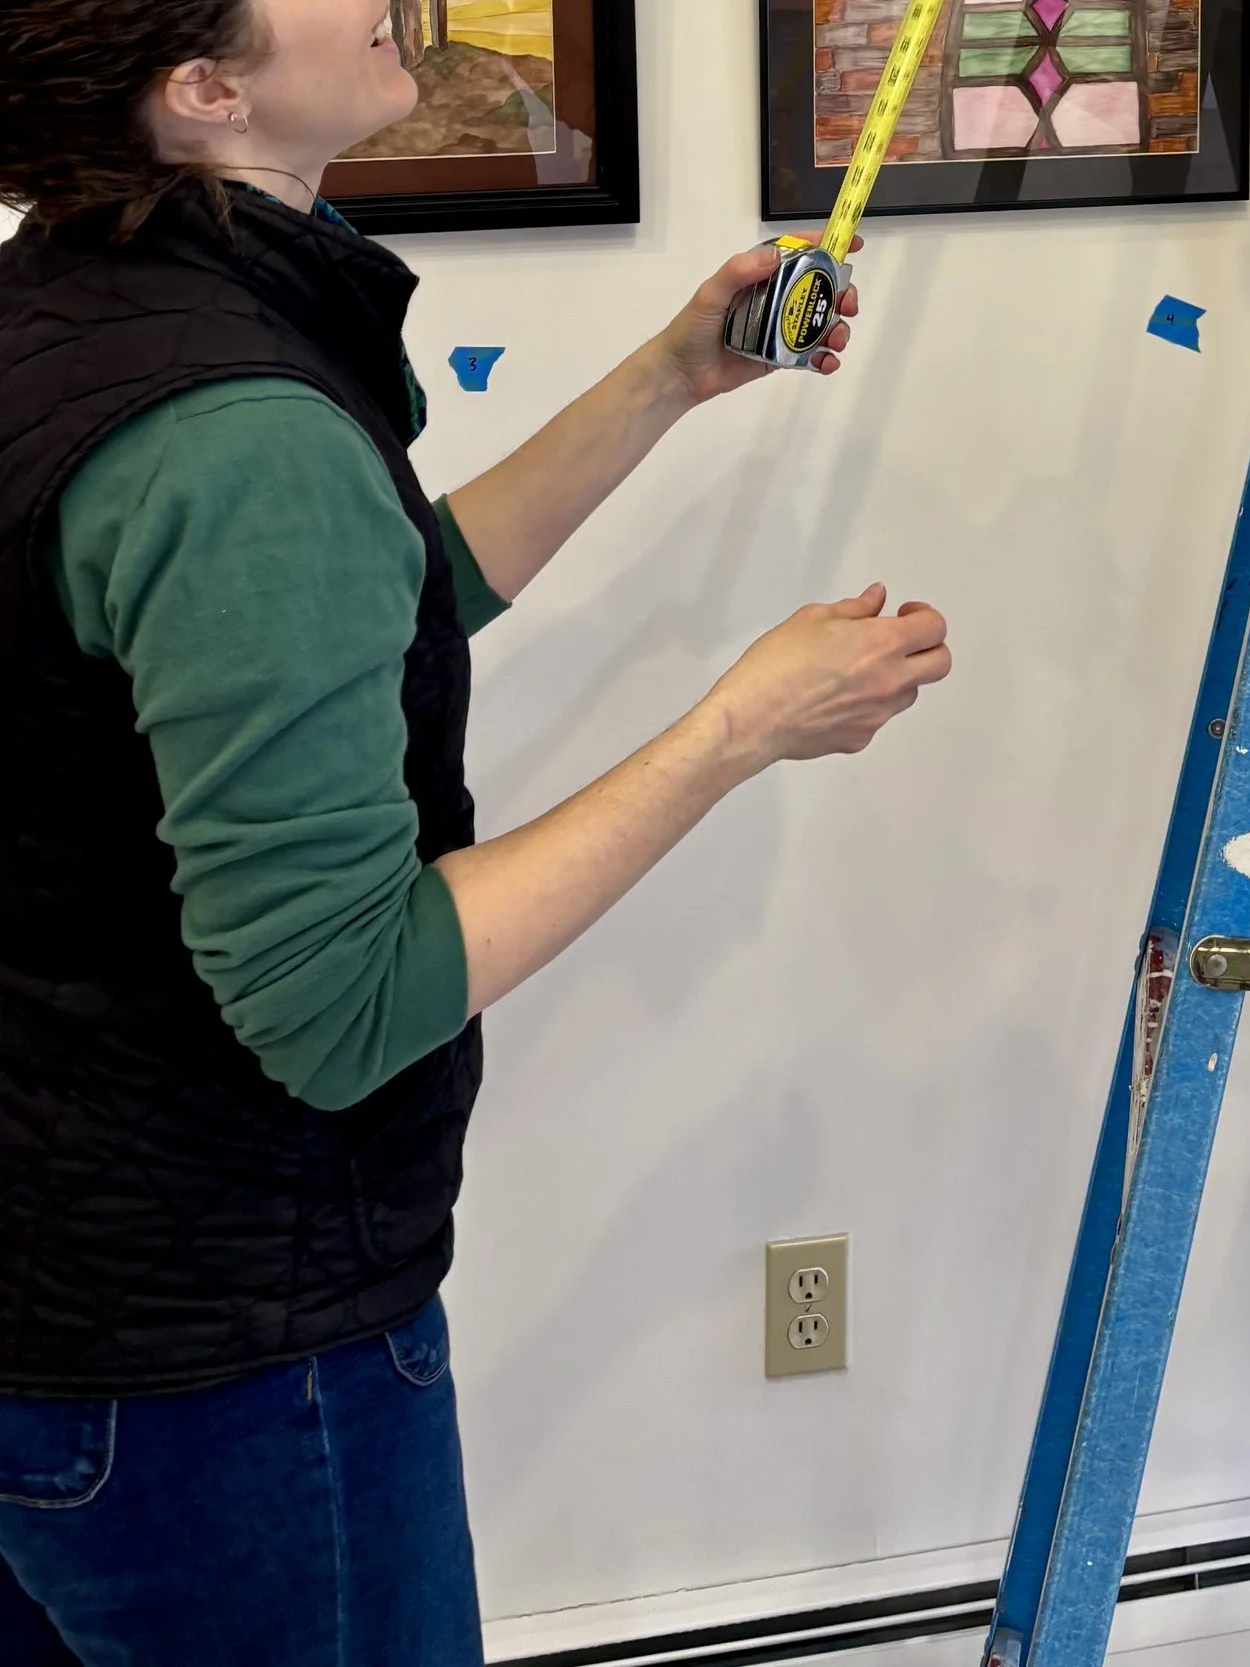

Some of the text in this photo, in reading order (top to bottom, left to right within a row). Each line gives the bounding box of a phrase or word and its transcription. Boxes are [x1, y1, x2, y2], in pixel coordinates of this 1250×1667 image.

[792, 288, 807, 330] STANLEY
[798, 278, 821, 343] POWERLOCK
[1166, 311, 1175, 325] 4
[468, 357, 477, 372] 3
